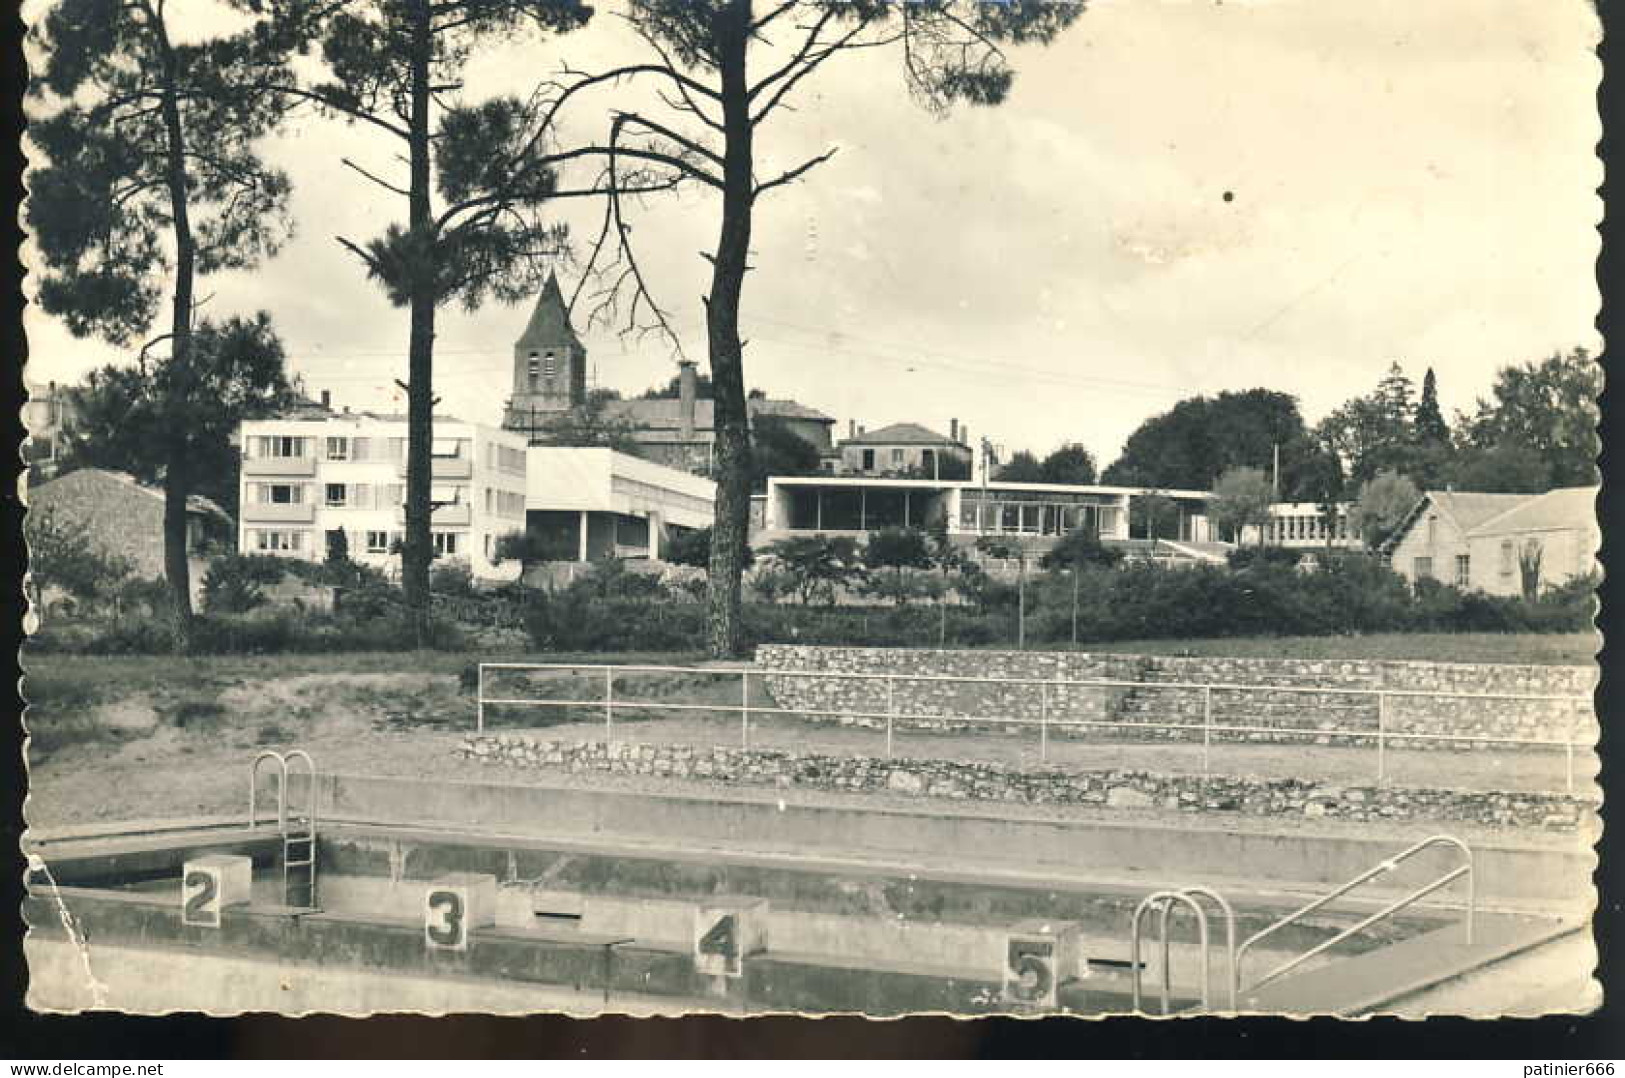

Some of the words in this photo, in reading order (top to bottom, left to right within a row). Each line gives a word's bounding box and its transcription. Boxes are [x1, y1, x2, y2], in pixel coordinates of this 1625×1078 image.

[185, 871, 219, 923] 2
[428, 891, 464, 945] 3
[698, 914, 735, 974] 4
[1009, 941, 1053, 1001] 5
